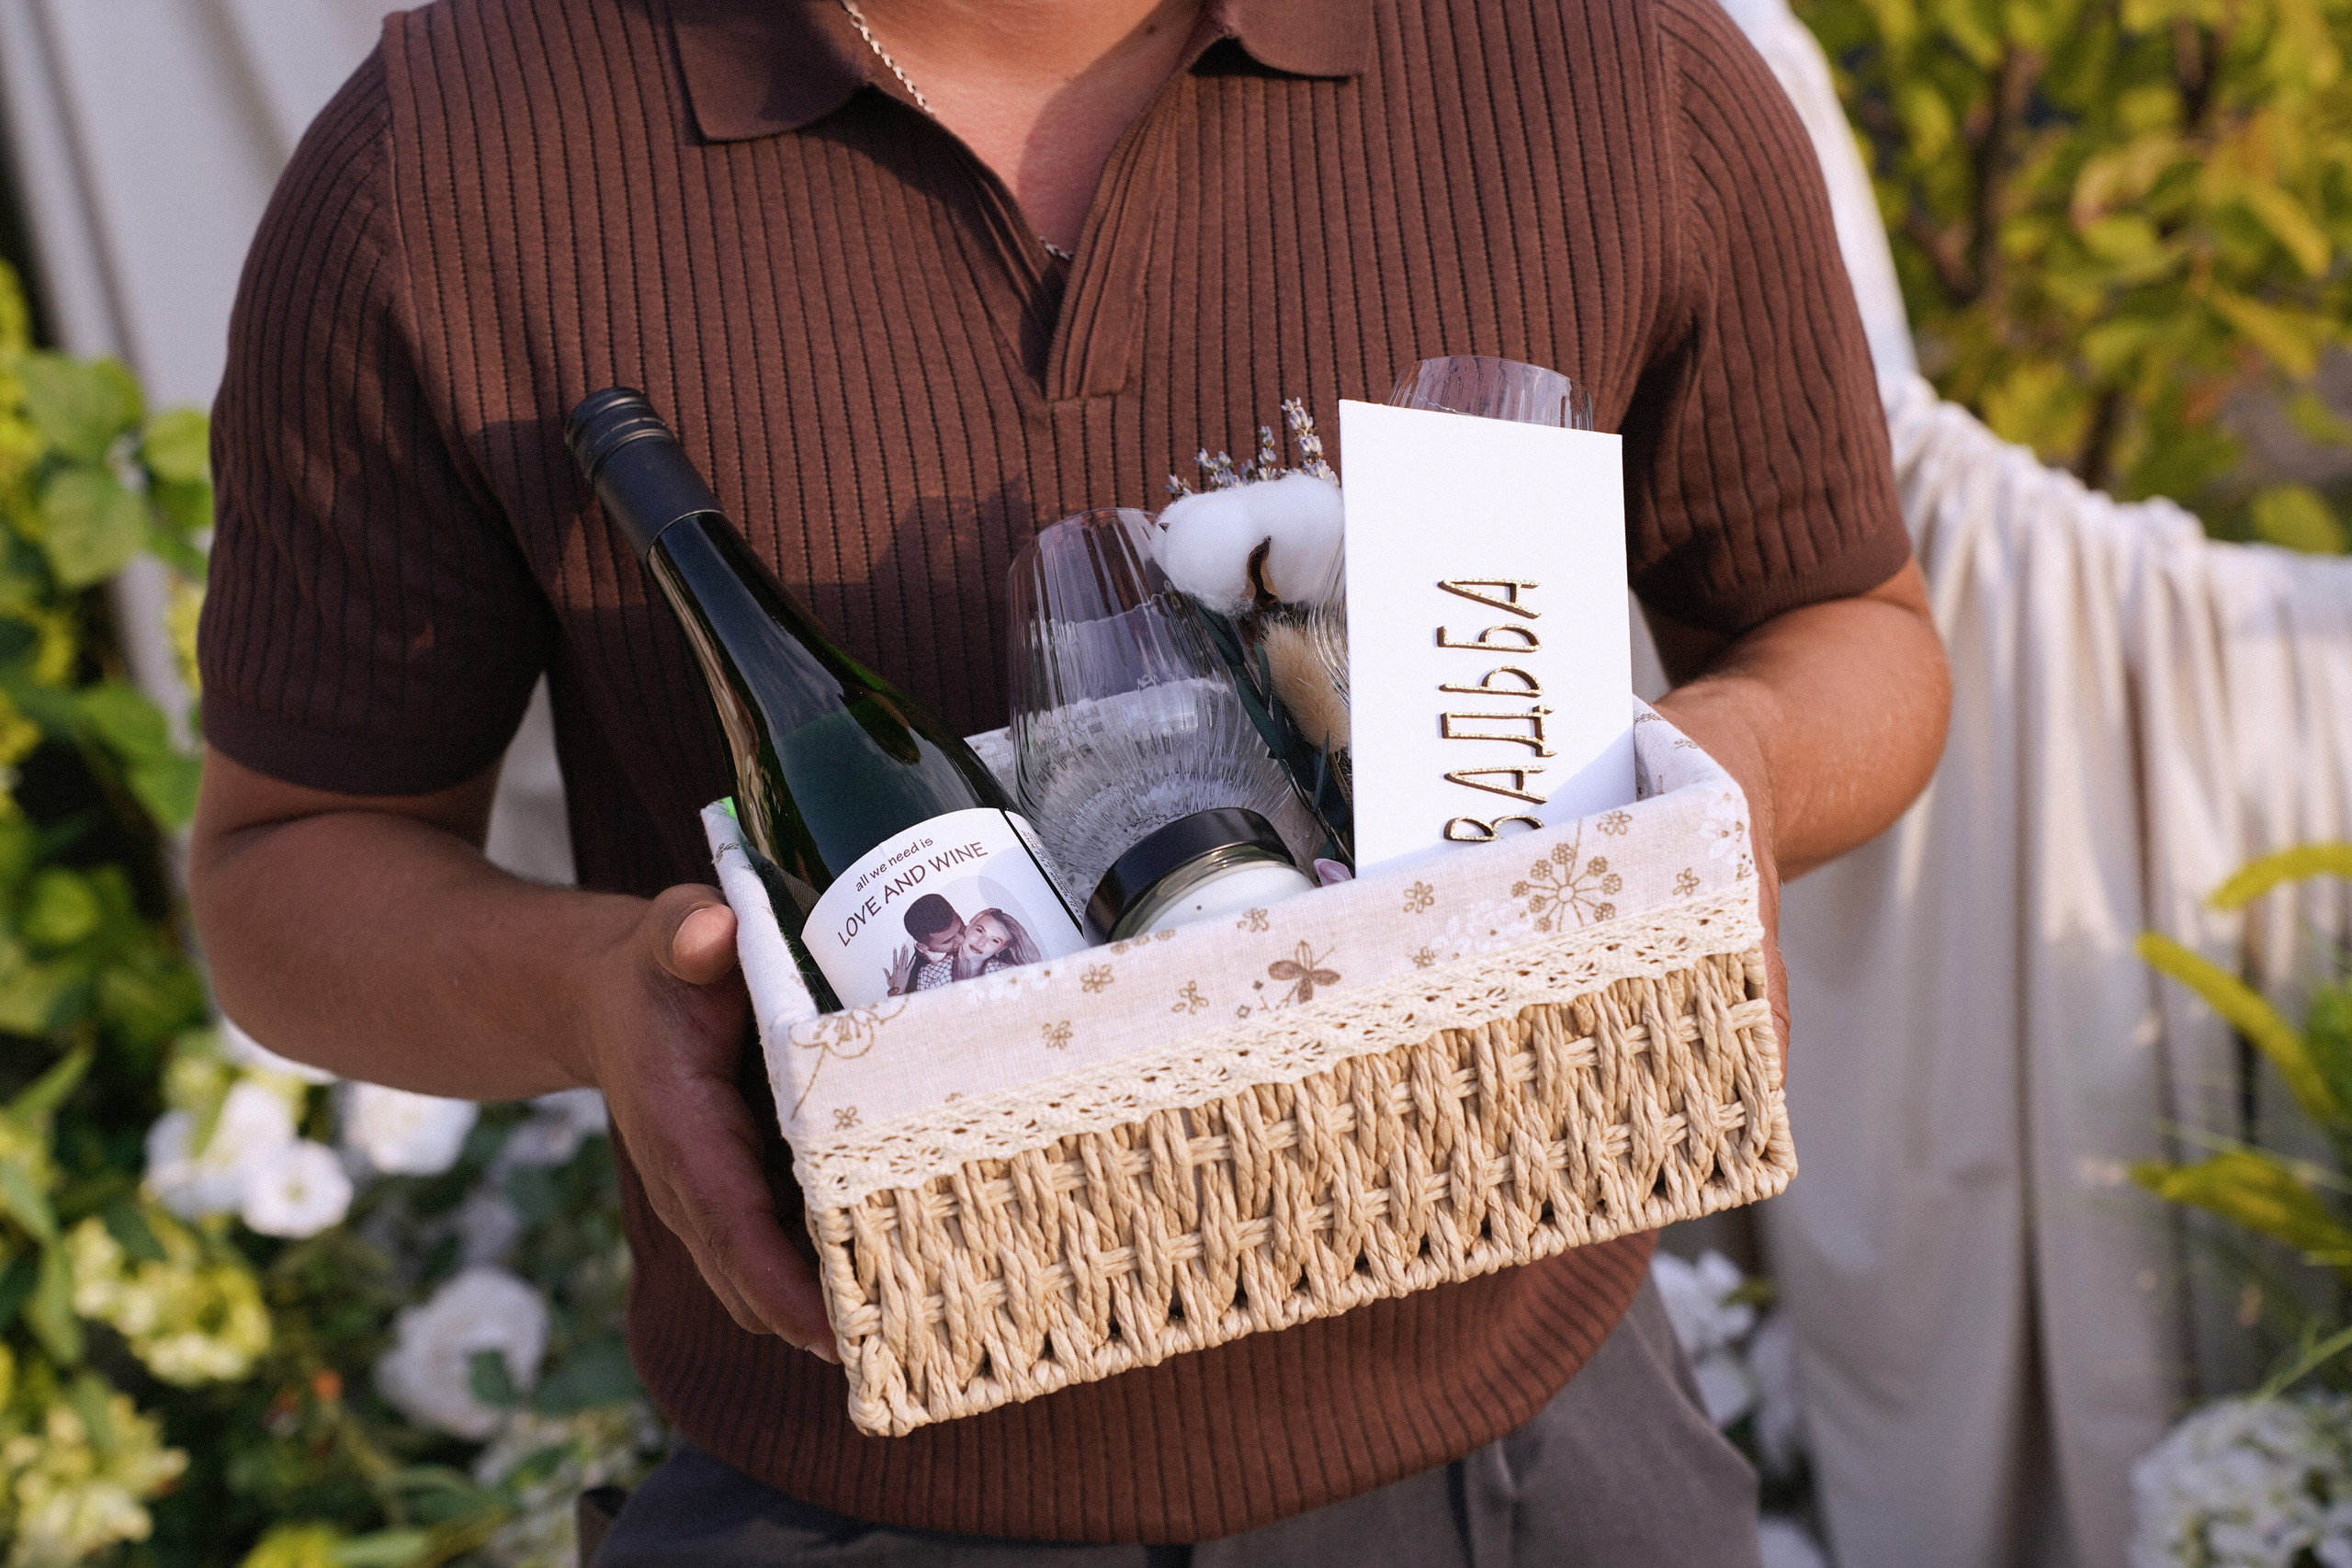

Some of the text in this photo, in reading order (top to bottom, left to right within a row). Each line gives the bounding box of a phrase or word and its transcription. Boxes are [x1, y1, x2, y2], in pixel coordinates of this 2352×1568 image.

[837, 841, 989, 947] LOVE AND WINE
[855, 837, 933, 892] all we need is
